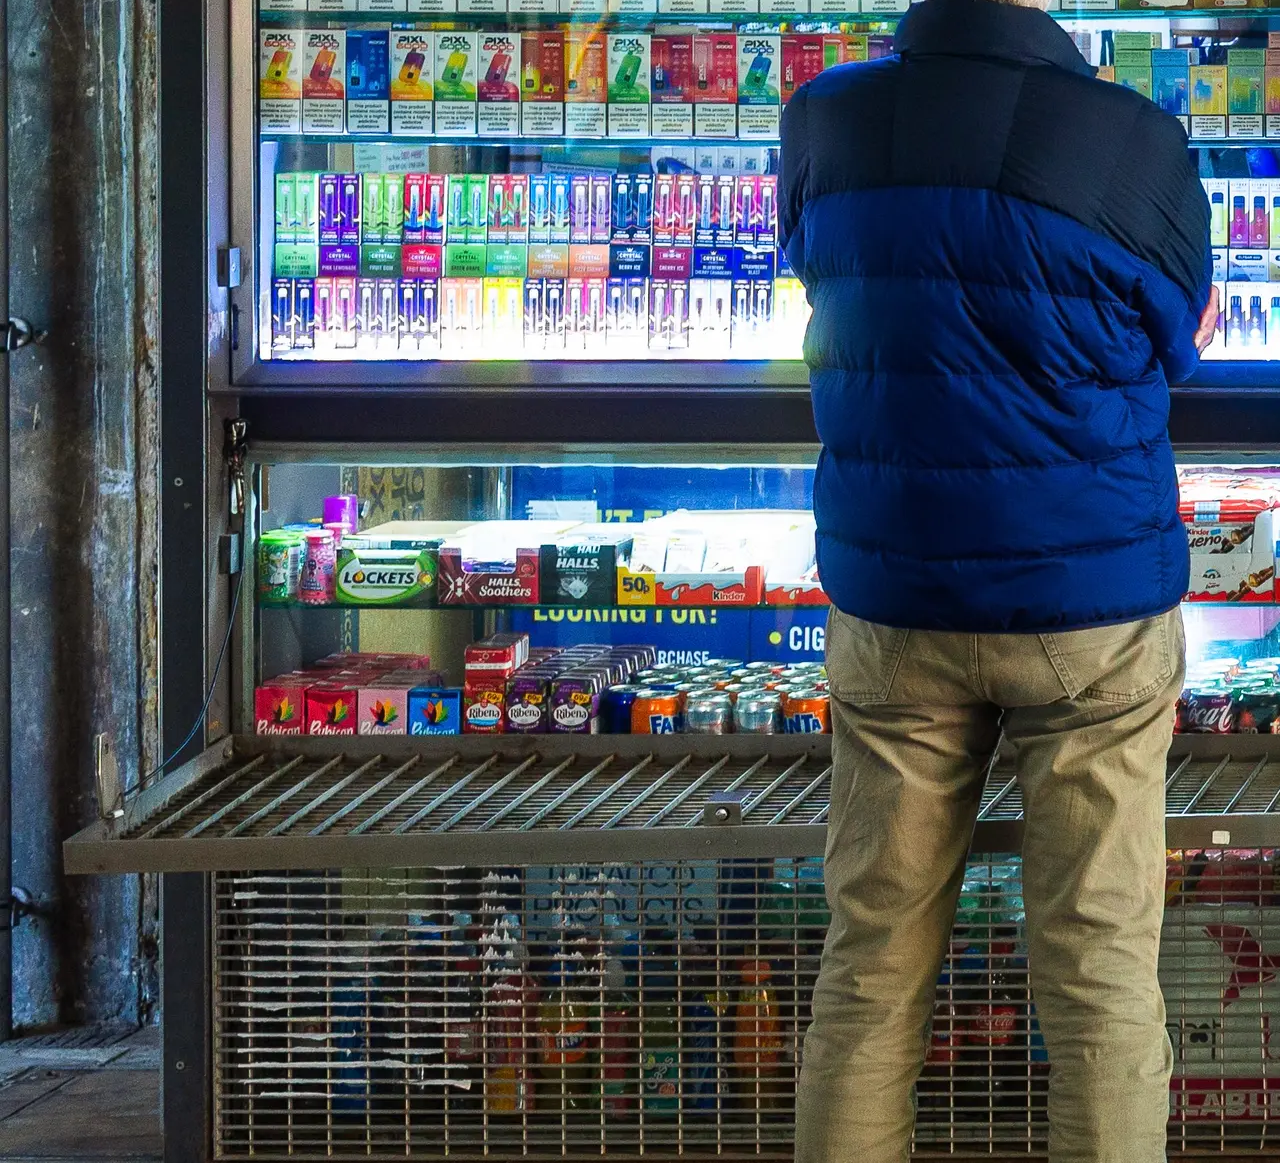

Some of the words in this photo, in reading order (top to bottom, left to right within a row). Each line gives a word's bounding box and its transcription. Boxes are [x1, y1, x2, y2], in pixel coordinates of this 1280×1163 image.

[344, 571, 414, 586] LOCKETS
[479, 585, 532, 598] Soothers
[622, 577, 650, 594] 50p
[712, 591, 745, 602] Kinder
[508, 707, 541, 720] Ribena
